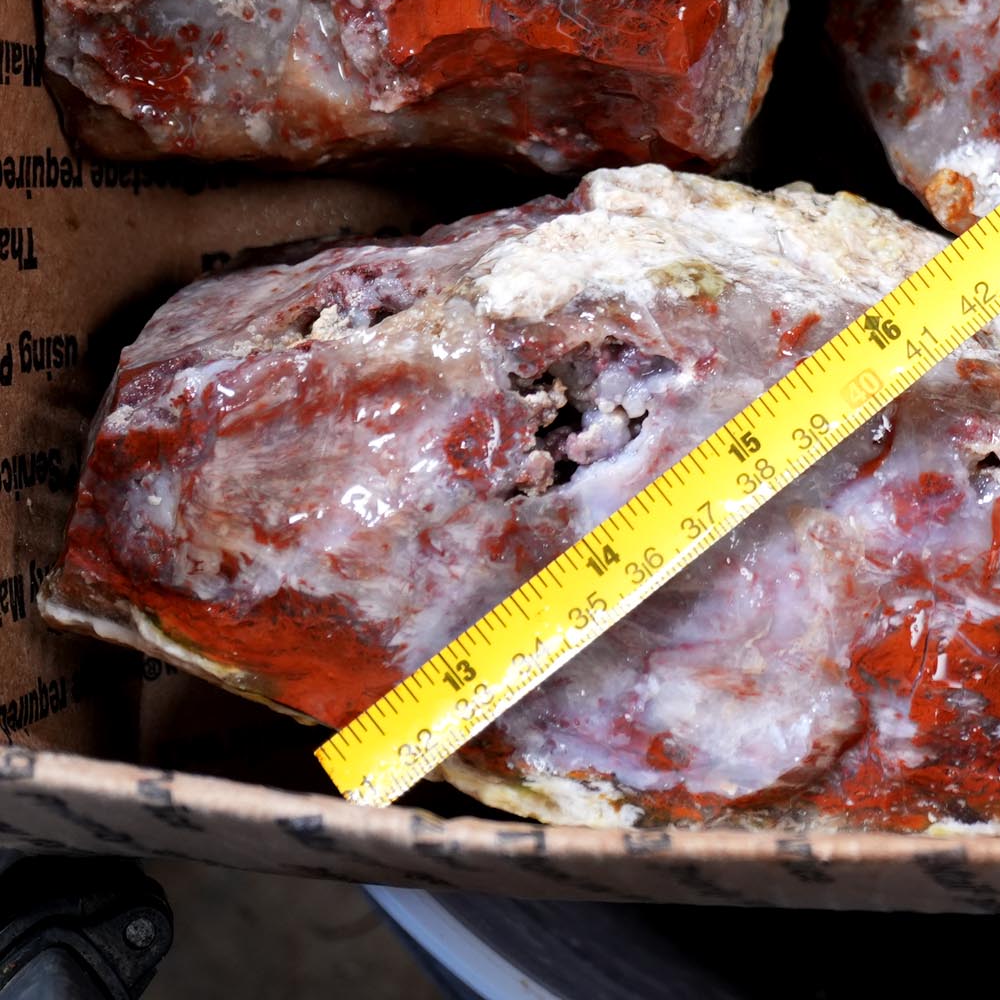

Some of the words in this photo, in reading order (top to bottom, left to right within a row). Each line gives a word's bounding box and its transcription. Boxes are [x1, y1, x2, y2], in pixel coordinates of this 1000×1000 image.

[18, 330, 78, 381] using
[443, 659, 477, 691] 13
[586, 544, 620, 576] 14
[728, 431, 761, 463] 15
[869, 319, 901, 350] 16
[568, 591, 607, 630] 35
[625, 546, 664, 584] 36
[680, 500, 714, 540] 37
[736, 458, 776, 495] 38
[792, 413, 830, 450] 39
[906, 326, 938, 360] 41
[961, 281, 996, 315] 42
